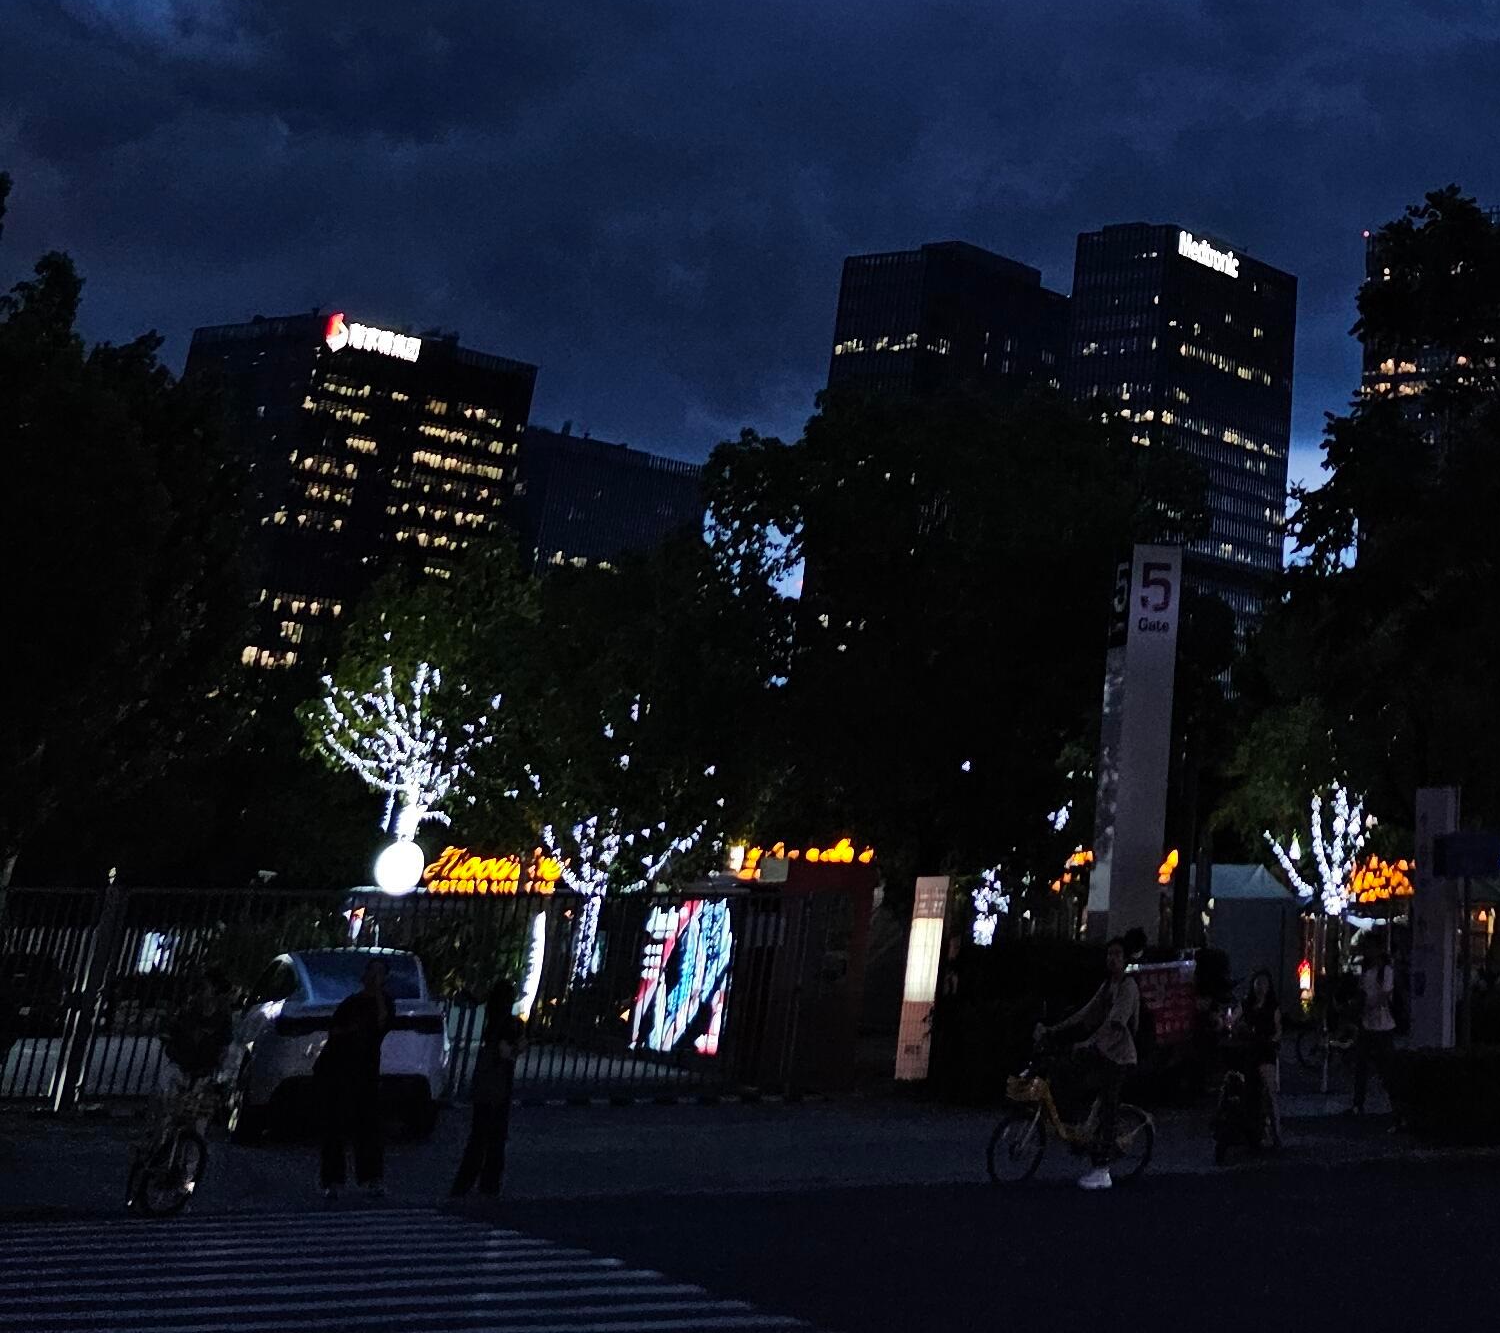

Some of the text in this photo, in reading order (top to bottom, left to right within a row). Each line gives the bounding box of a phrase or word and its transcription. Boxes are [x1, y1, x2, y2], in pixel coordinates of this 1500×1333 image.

[1179, 231, 1239, 278] Medtronic
[1141, 563, 1171, 612] 5
[1138, 617, 1169, 632] Gate
